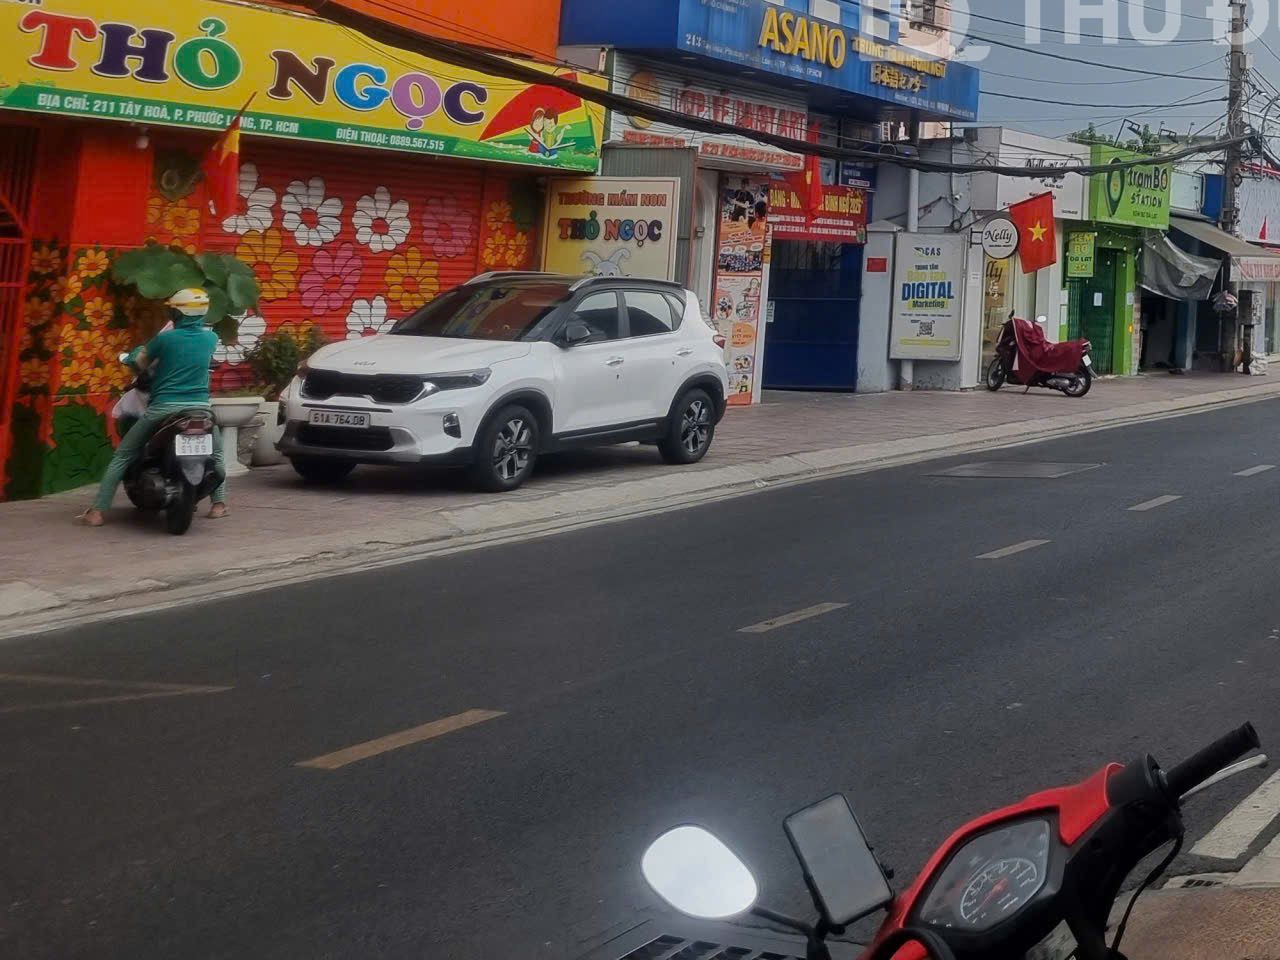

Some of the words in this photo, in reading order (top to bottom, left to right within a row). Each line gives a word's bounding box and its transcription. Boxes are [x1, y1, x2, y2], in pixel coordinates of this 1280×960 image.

[685, 33, 701, 46] 213
[758, 7, 846, 69] ASANO
[19, 9, 243, 91] THỎ
[267, 49, 488, 131] NGỌC
[37, 93, 61, 110] ĐỊA
[64, 93, 90, 111] CHỈ:
[93, 99, 115, 114] 211
[119, 98, 141, 116] TÂY
[173, 108, 184, 122] P.
[186, 107, 223, 126] PHƯỚC
[260, 118, 273, 131] TP.
[275, 121, 300, 134] HCM
[336, 128, 358, 144] ĐIỆN
[360, 130, 389, 147] THOẠI:
[558, 190, 604, 206] TRƯỜNG
[640, 193, 667, 207] NON
[1131, 192, 1162, 208] STATION
[558, 210, 600, 240] THỎ
[604, 219, 662, 247] NGỌC
[984, 228, 1012, 244] Nelly
[902, 281, 954, 301] DIGITAL
[912, 300, 945, 309] Marketing
